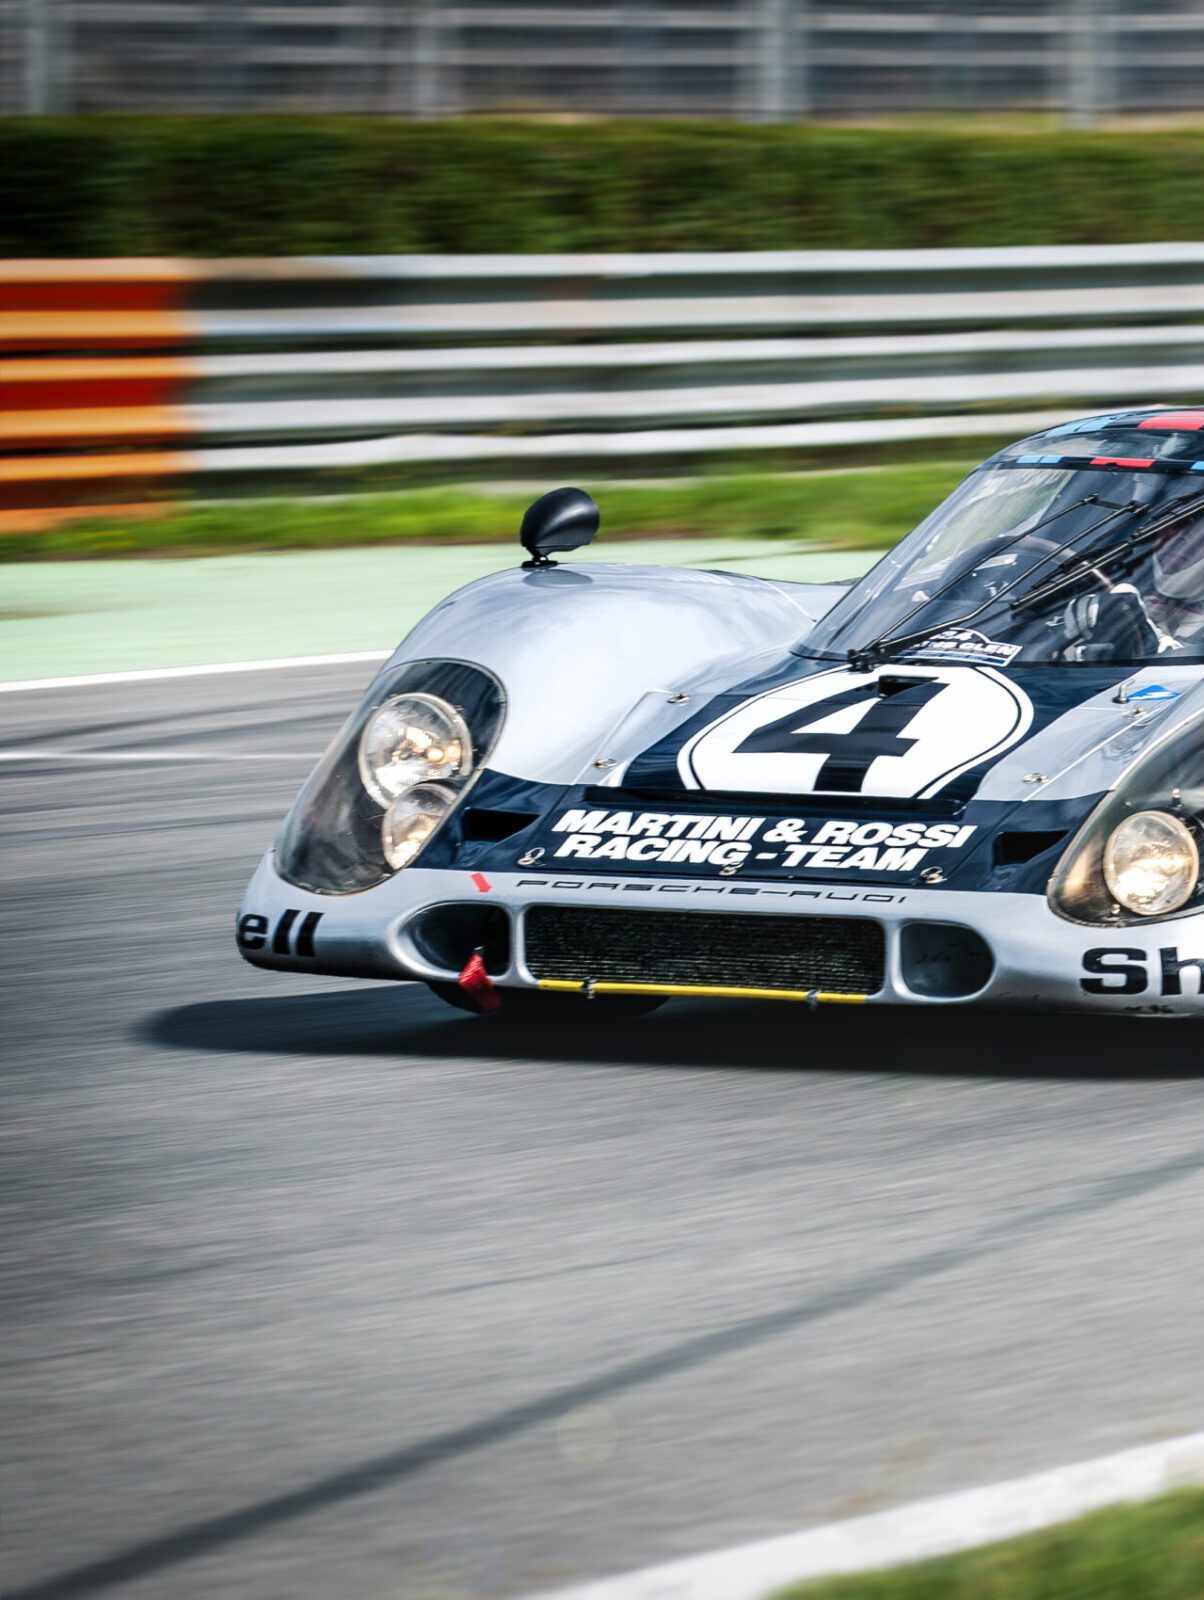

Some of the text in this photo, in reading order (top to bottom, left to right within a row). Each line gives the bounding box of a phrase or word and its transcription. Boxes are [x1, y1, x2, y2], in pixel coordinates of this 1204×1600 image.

[731, 674, 951, 793] 4
[551, 809, 979, 849] MARTINI & ROSSI
[516, 880, 908, 904] PORSCHE-AUDI
